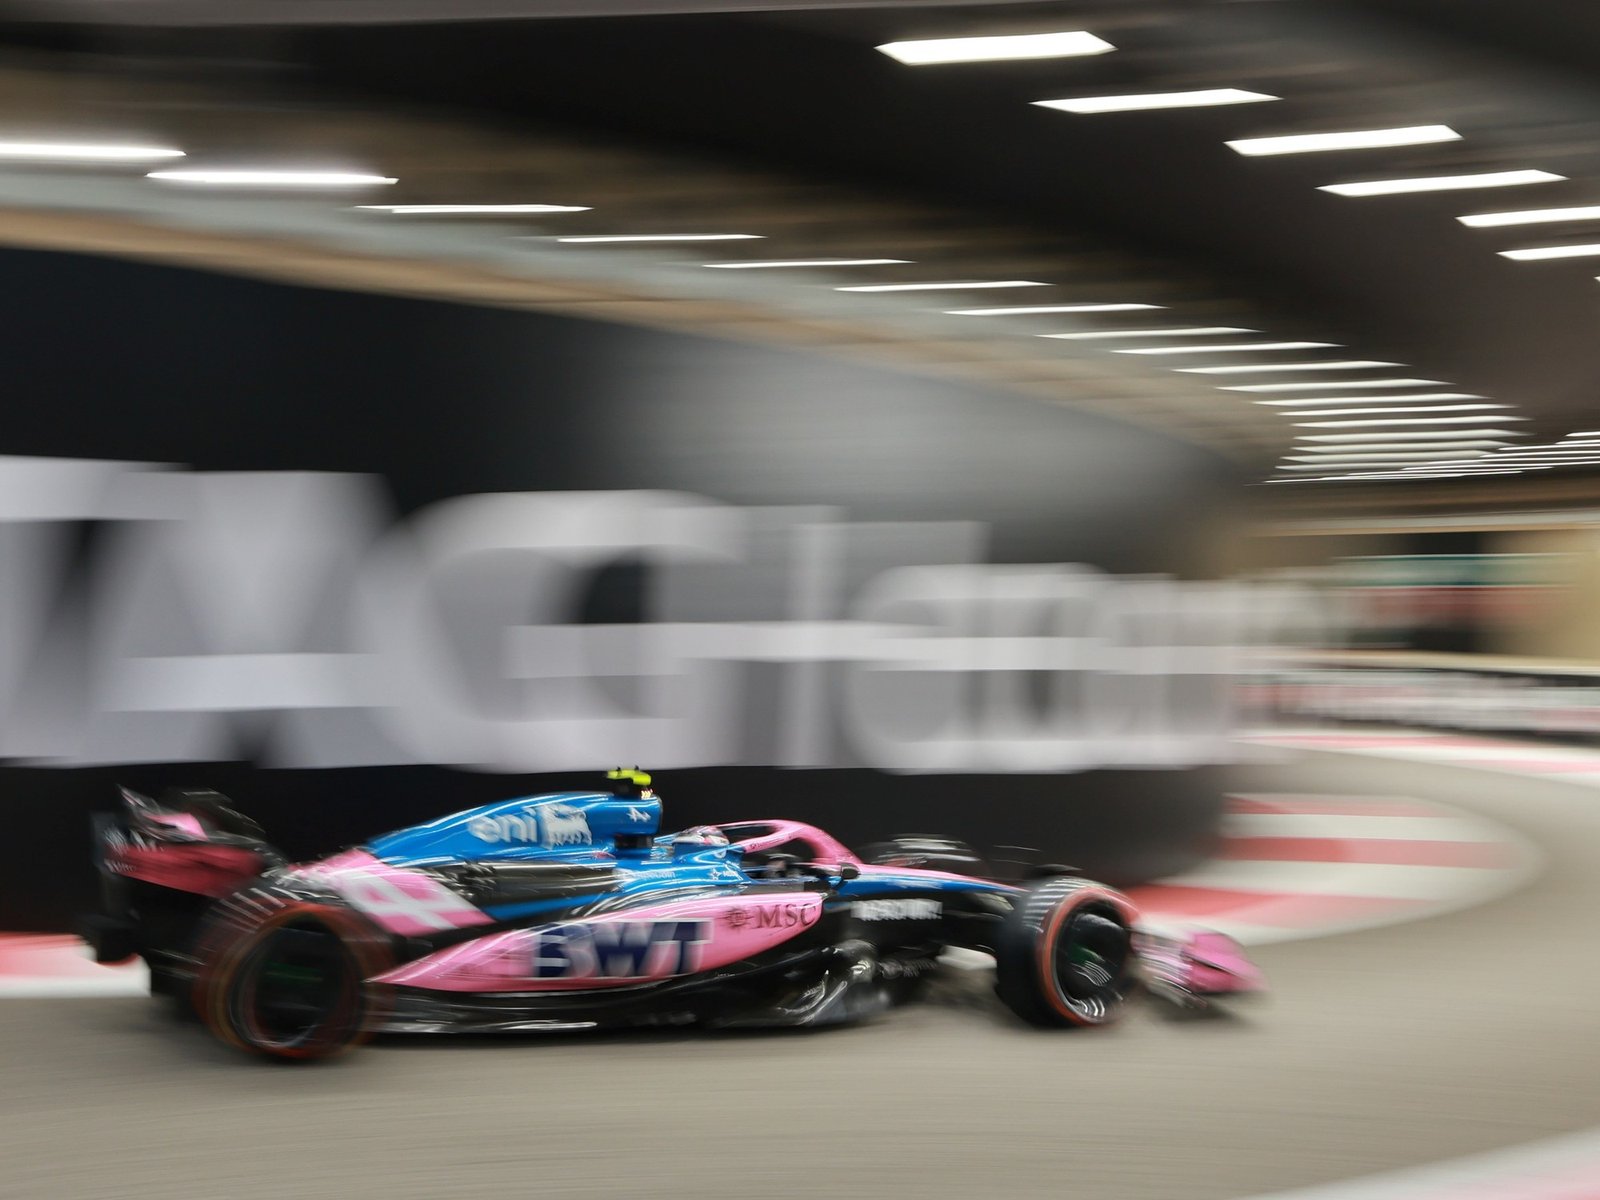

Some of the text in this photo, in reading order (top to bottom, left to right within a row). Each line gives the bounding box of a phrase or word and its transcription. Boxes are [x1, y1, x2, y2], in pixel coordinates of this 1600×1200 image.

[468, 807, 537, 843] eni
[754, 903, 817, 928] MSC
[532, 921, 714, 978] BWT
